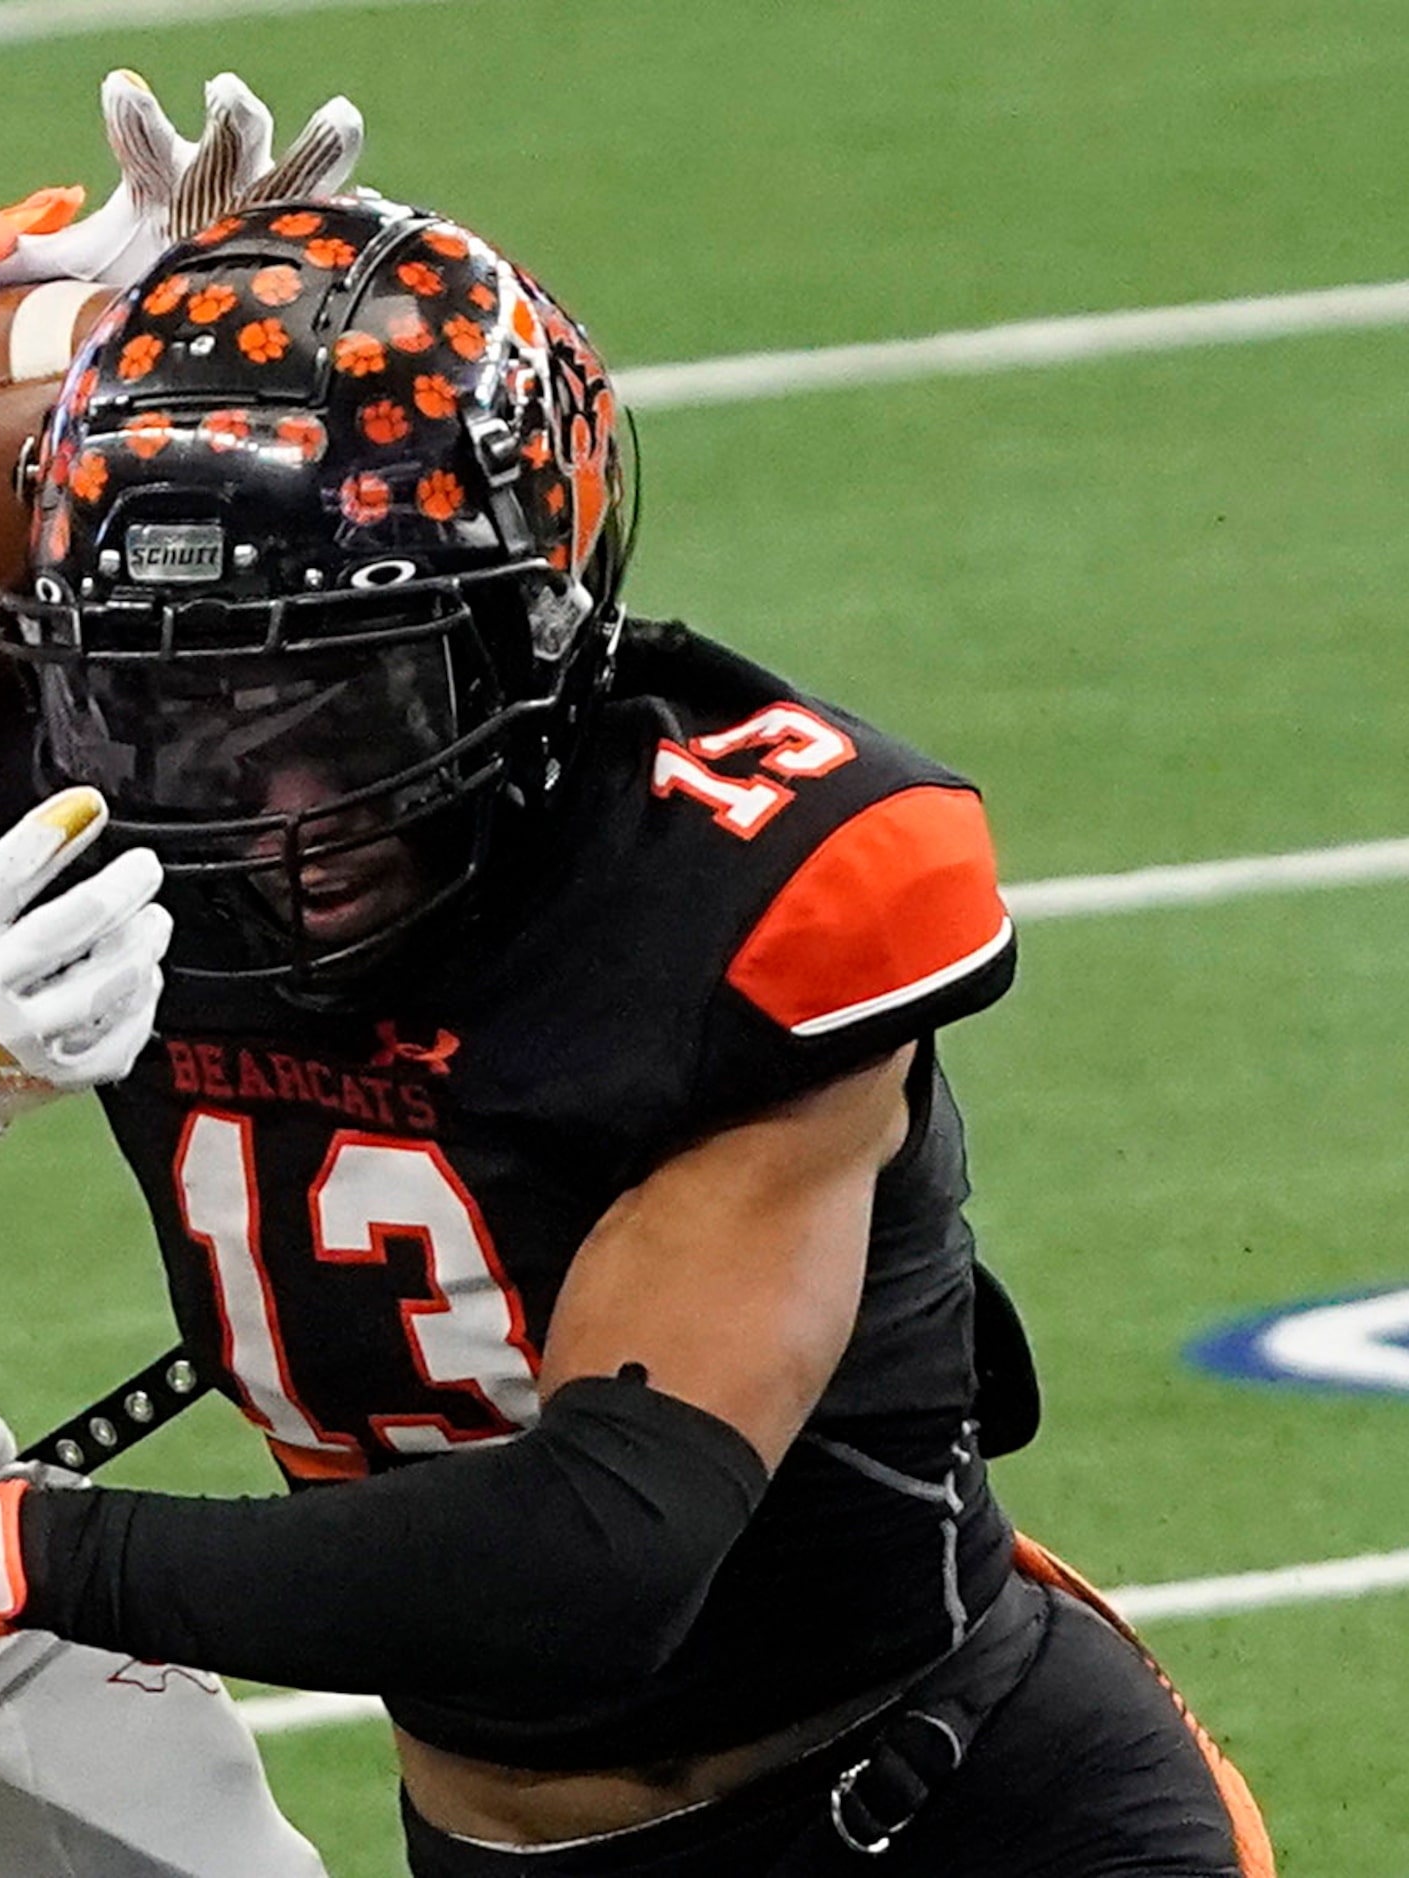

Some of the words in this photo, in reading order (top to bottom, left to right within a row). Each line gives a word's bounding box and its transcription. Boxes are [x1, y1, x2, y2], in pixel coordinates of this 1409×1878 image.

[651, 701, 858, 841] 13
[166, 1040, 437, 1129] BEARCATS
[173, 1105, 543, 1454] 13
